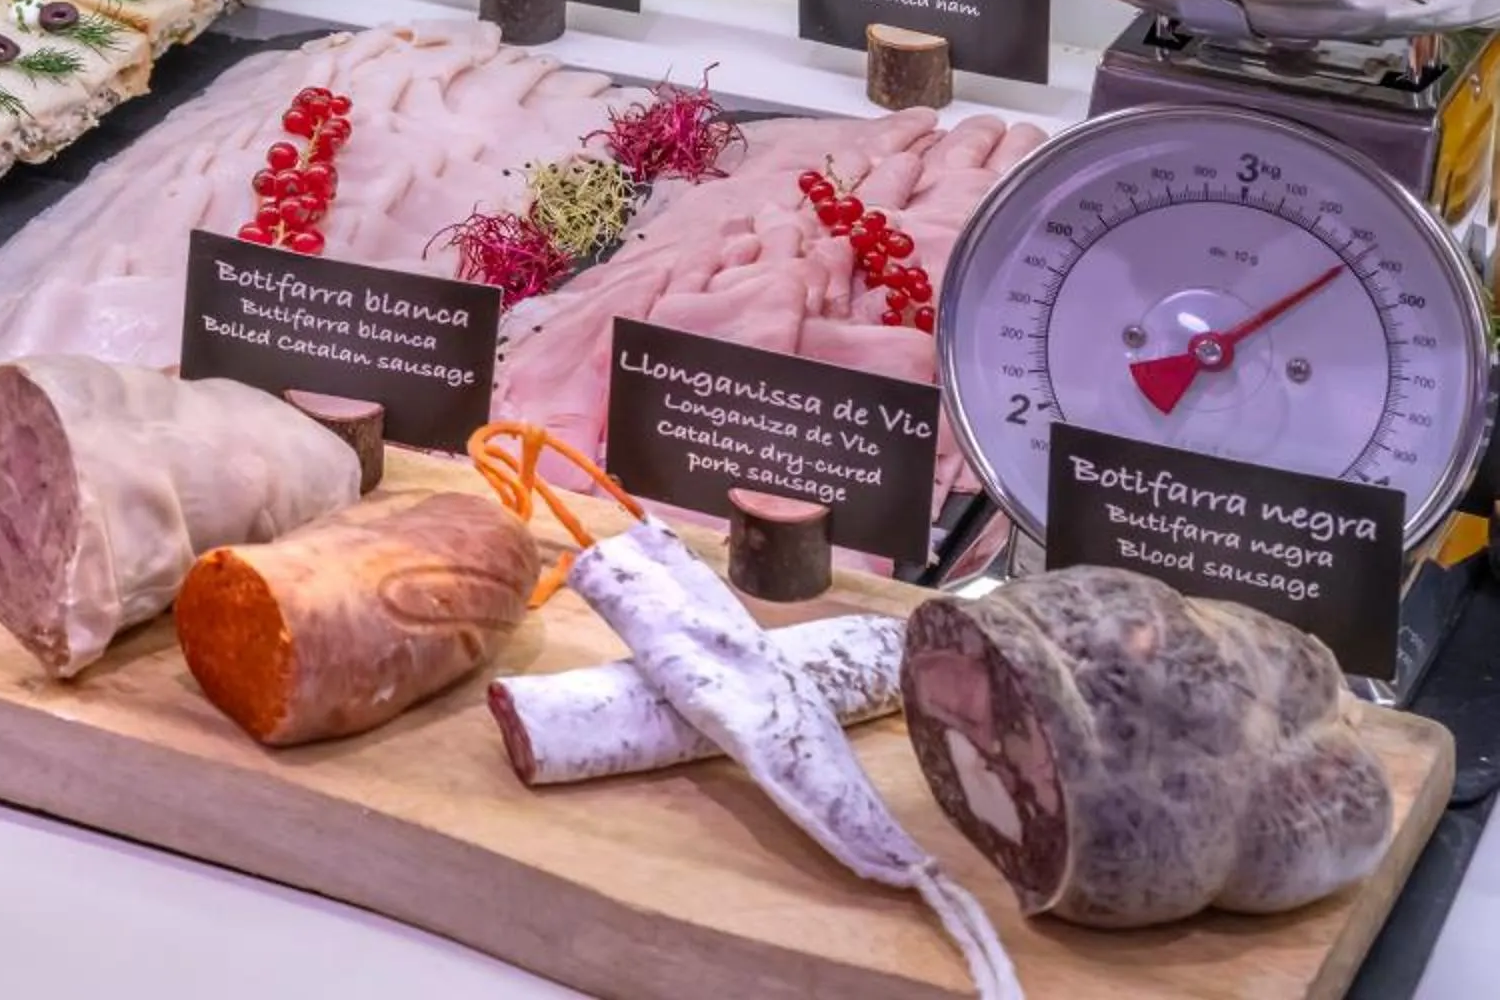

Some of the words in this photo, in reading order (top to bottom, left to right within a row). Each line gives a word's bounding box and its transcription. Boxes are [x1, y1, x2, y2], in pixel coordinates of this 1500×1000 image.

[1236, 153, 1260, 183] 3
[1260, 163, 1282, 181] kg
[1285, 182, 1308, 198] 100
[1046, 221, 1073, 238] 500
[1319, 201, 1343, 216] 200
[214, 259, 353, 309] Botifarra
[365, 288, 470, 328] blanca
[1399, 293, 1426, 310] 500
[240, 297, 350, 331] Butifarra
[358, 319, 437, 351] blanca
[1000, 326, 1025, 341] 200
[202, 314, 270, 346] Boiled
[277, 335, 372, 366] Catalan
[377, 354, 476, 388] sausage
[1002, 364, 1024, 379] 100
[619, 350, 822, 417] Llonganissa
[833, 399, 870, 426] de
[878, 404, 934, 440] Vic
[1414, 375, 1436, 390] 700
[665, 393, 798, 439] Longaniza
[805, 424, 833, 448] de
[840, 431, 880, 457] Vic
[1004, 394, 1032, 426] 2
[657, 419, 754, 456] Catalan
[759, 445, 883, 486] dry-cured
[686, 451, 742, 479] pork
[746, 465, 848, 504] sausage
[1068, 454, 1248, 518] Botifarra
[1261, 502, 1378, 542] negra
[1105, 503, 1242, 550] Butifarra
[1250, 538, 1334, 569] negra
[1116, 537, 1196, 573] Blood
[1202, 560, 1322, 602] sausage
